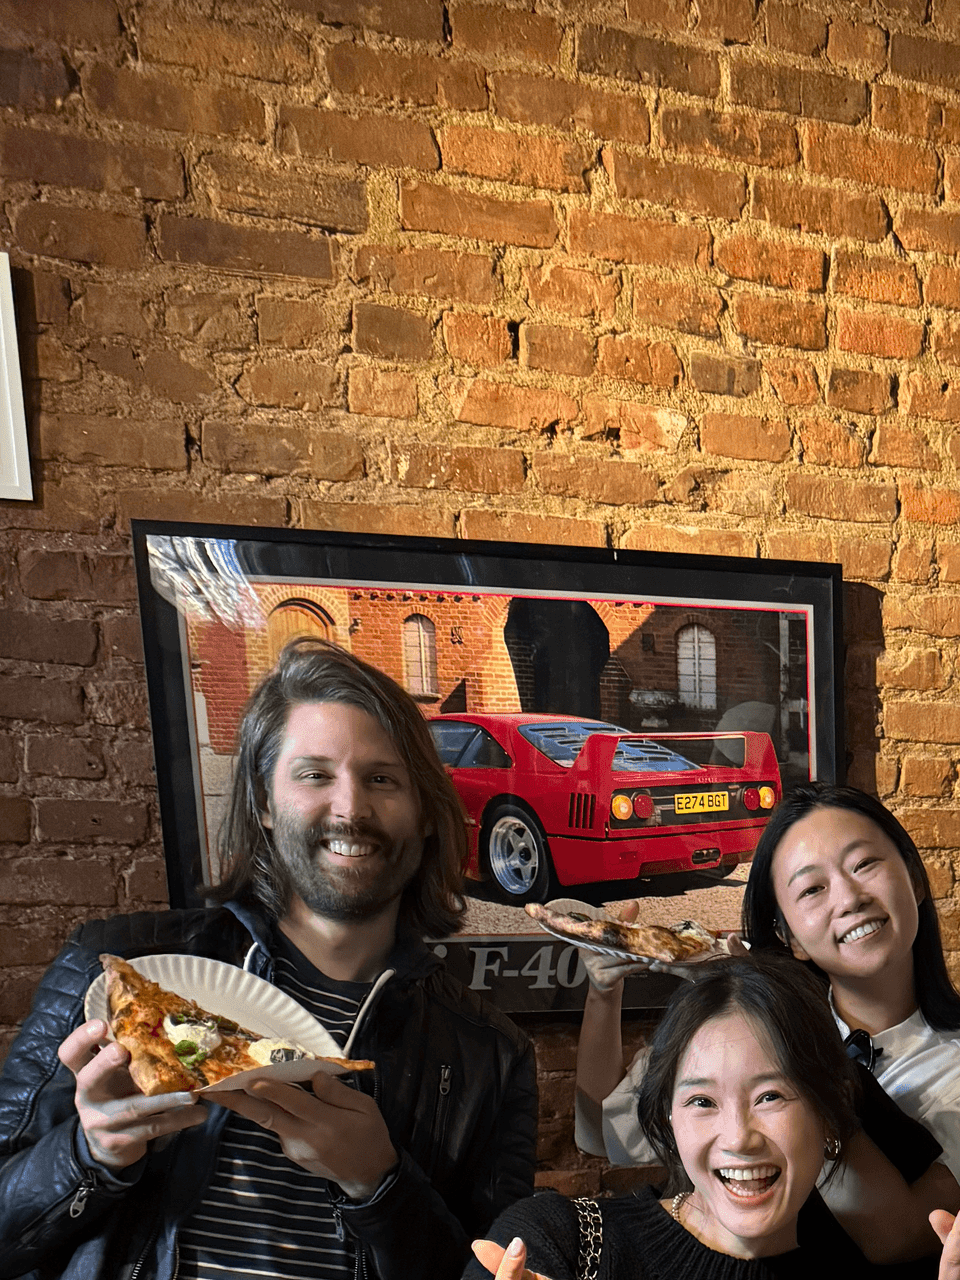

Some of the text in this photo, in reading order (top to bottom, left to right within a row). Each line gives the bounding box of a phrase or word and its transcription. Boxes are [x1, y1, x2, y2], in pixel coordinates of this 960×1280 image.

[676, 793, 727, 810] E274 BGT
[467, 944, 589, 991] F-40
